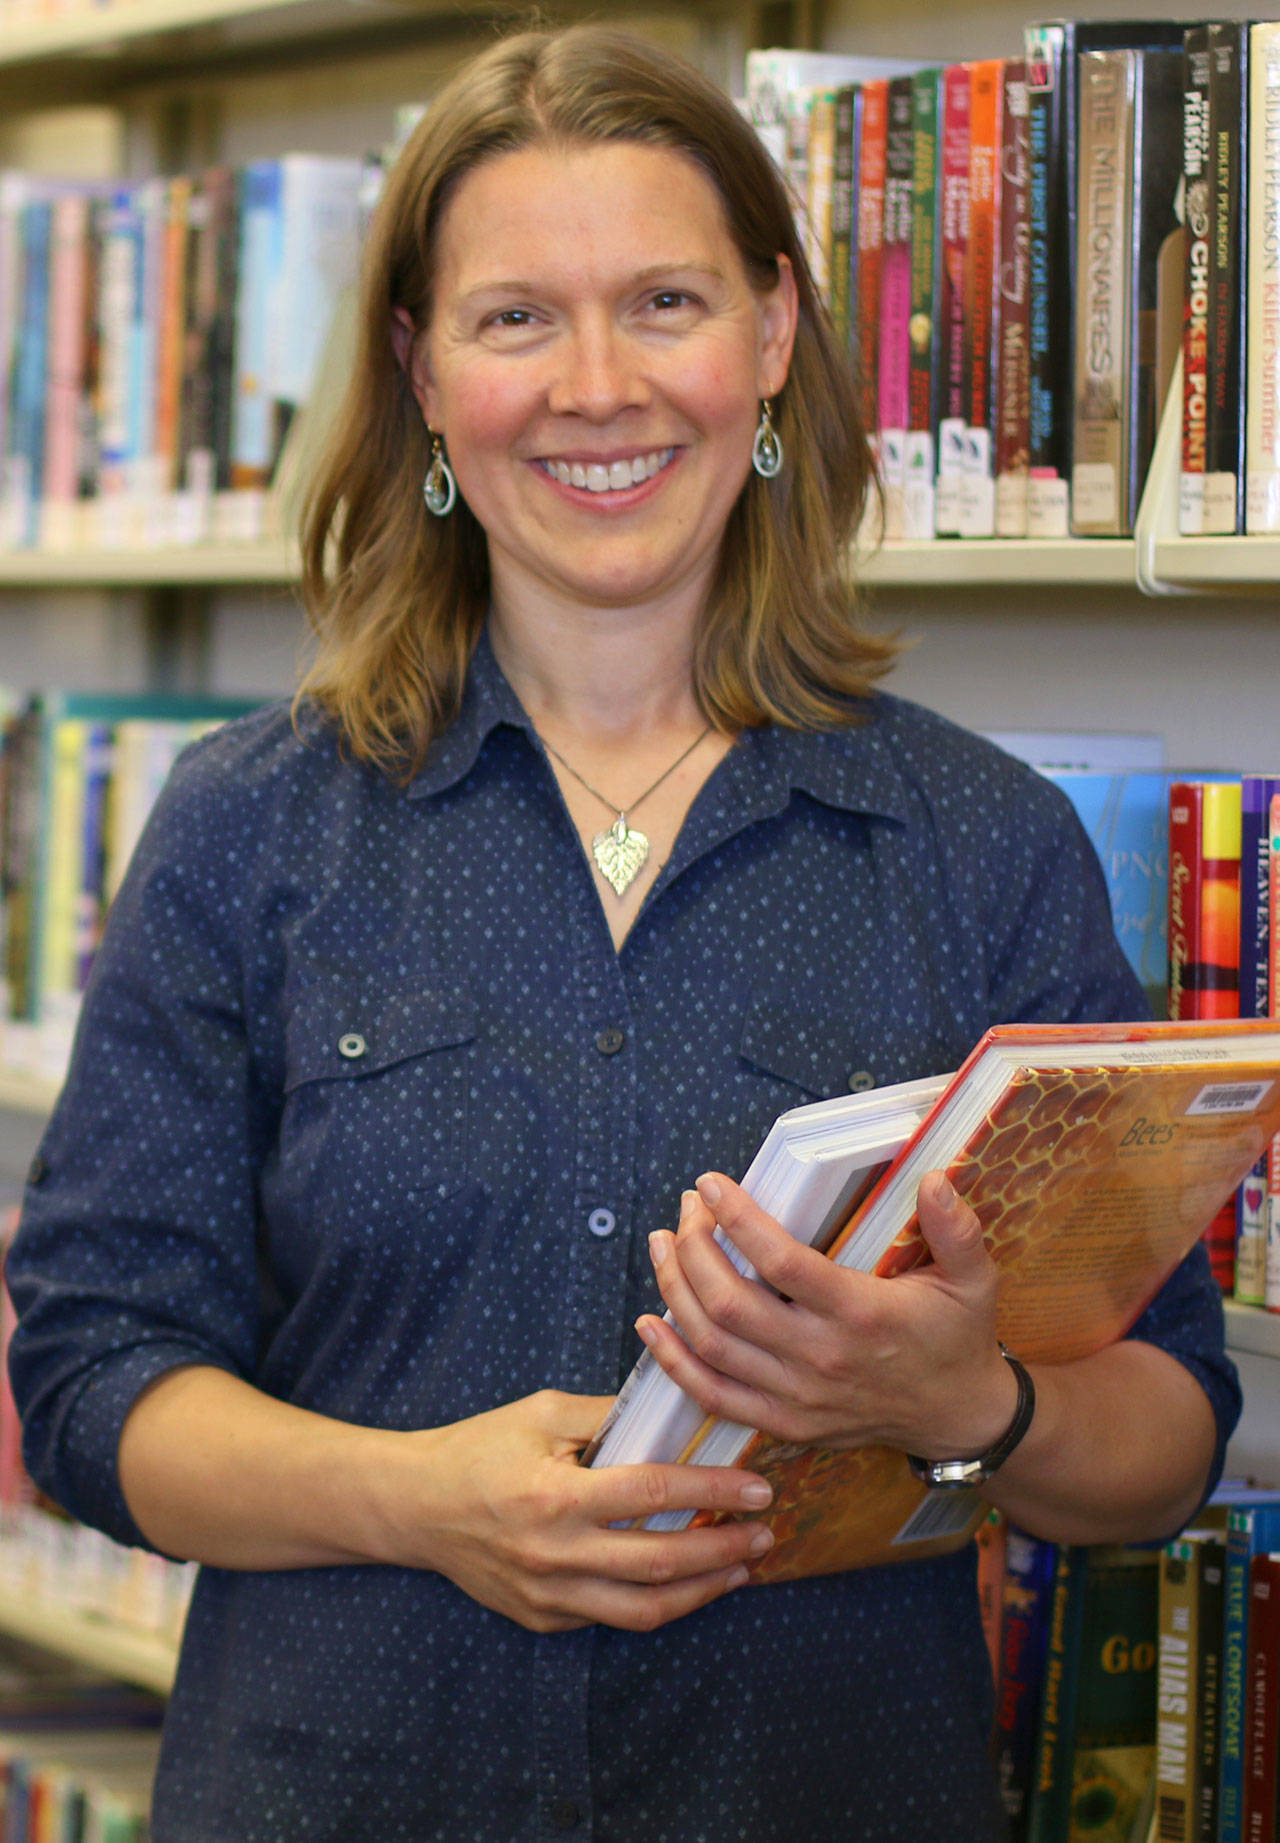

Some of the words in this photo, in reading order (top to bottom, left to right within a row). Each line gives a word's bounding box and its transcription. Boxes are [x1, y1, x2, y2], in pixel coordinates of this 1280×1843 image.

[1093, 71, 1119, 134] THE
[1184, 92, 1203, 176] PEARSON
[1216, 131, 1229, 188] RIDLEY
[1089, 148, 1117, 376] MILLIONAIRES
[1216, 193, 1229, 269] PEARSON
[1189, 241, 1208, 359] CHOKE
[1187, 371, 1207, 471] POINT
[1171, 852, 1191, 929] Secret
[1119, 1117, 1180, 1147] Bees
[1228, 1565, 1245, 1624] BLUE
[1159, 1633, 1189, 1715] ALIAS
[1225, 1631, 1244, 1760] LONESOME
[1157, 1721, 1188, 1785] MAN
[1252, 1653, 1267, 1780] CAMOUFLAGE
